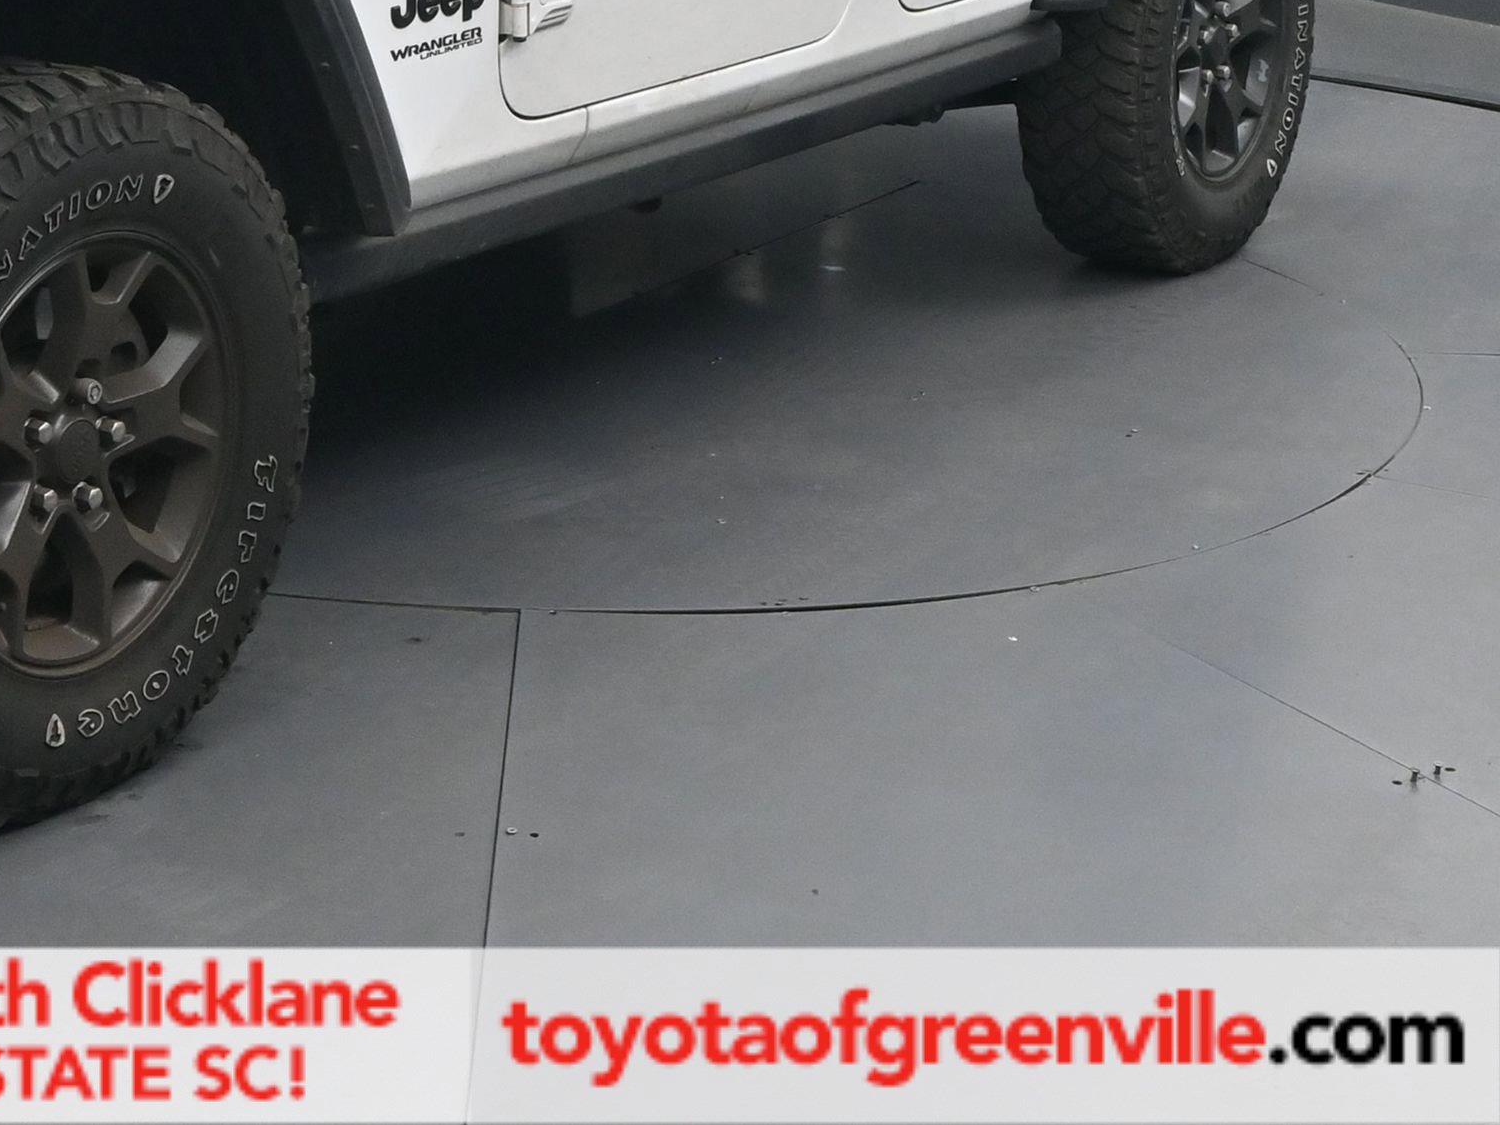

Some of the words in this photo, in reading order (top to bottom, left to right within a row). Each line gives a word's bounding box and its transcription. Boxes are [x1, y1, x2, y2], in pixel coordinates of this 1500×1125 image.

[390, 26, 482, 62] WRANGLER
[419, 37, 483, 61] UNLIMITED
[77, 455, 280, 738] Firestone
